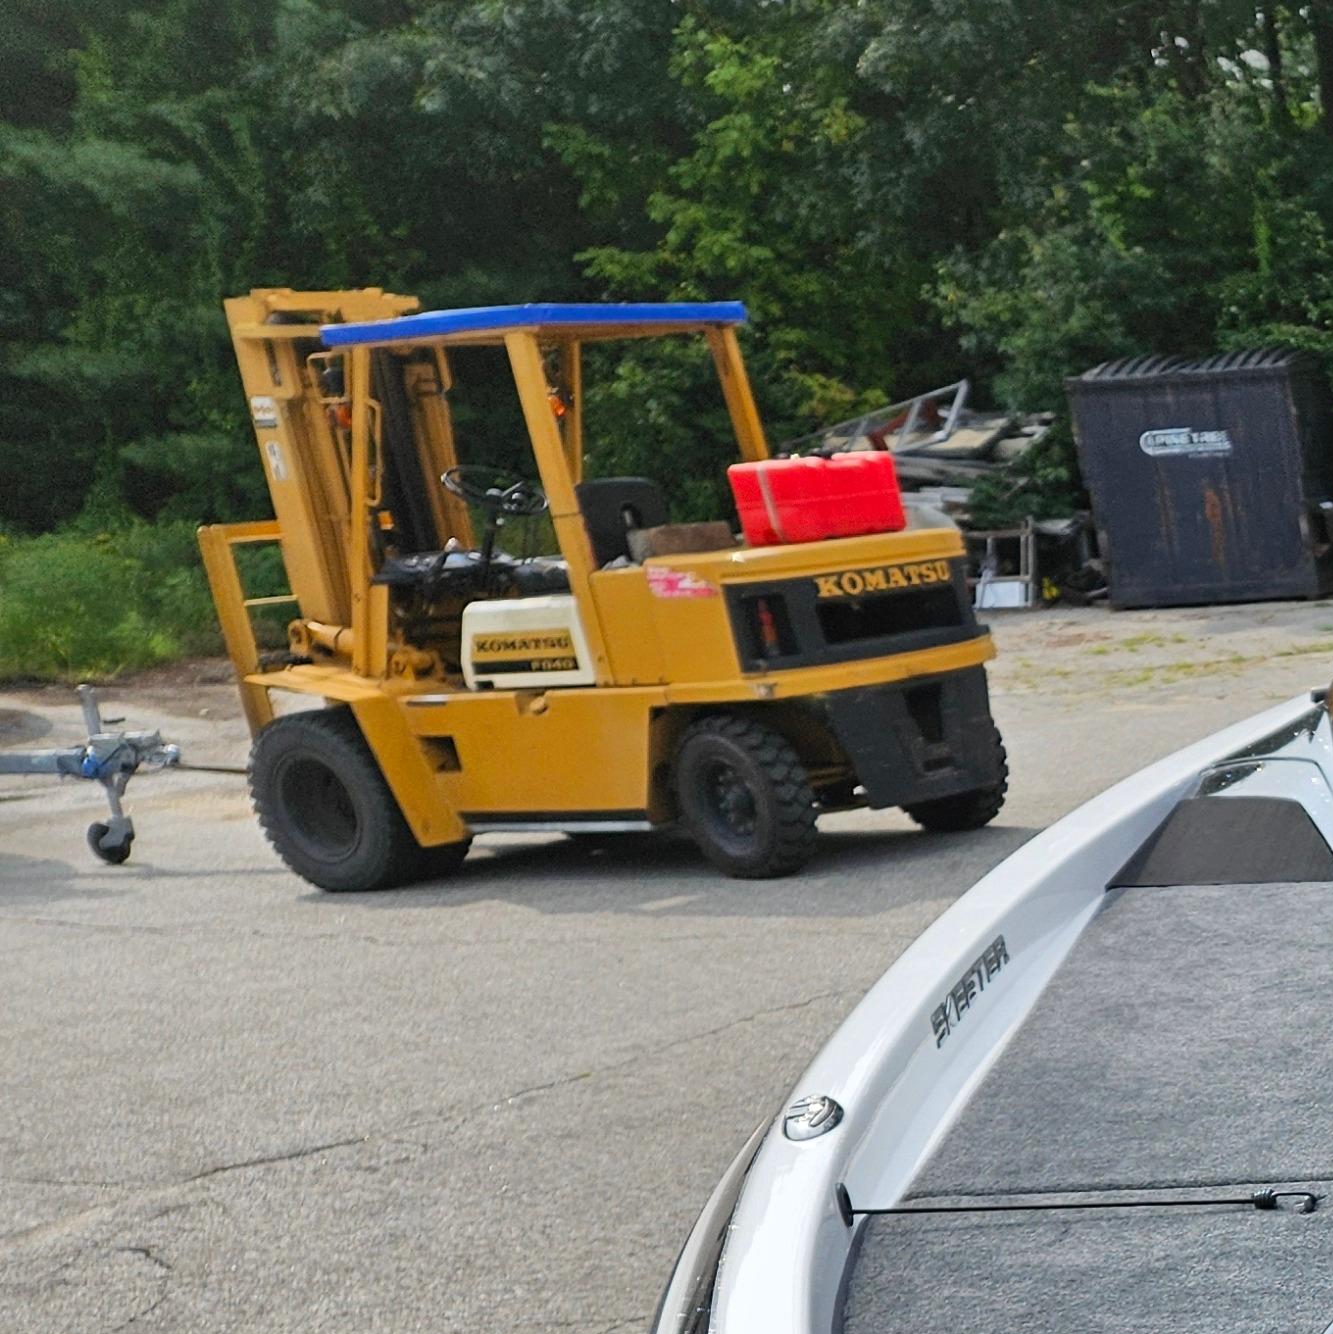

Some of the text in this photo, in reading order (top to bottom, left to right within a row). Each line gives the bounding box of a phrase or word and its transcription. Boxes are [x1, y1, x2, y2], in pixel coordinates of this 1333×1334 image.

[815, 560, 950, 598] KOMATSU
[475, 636, 569, 653] KOMATSU
[930, 933, 1010, 1050] SKEETER
